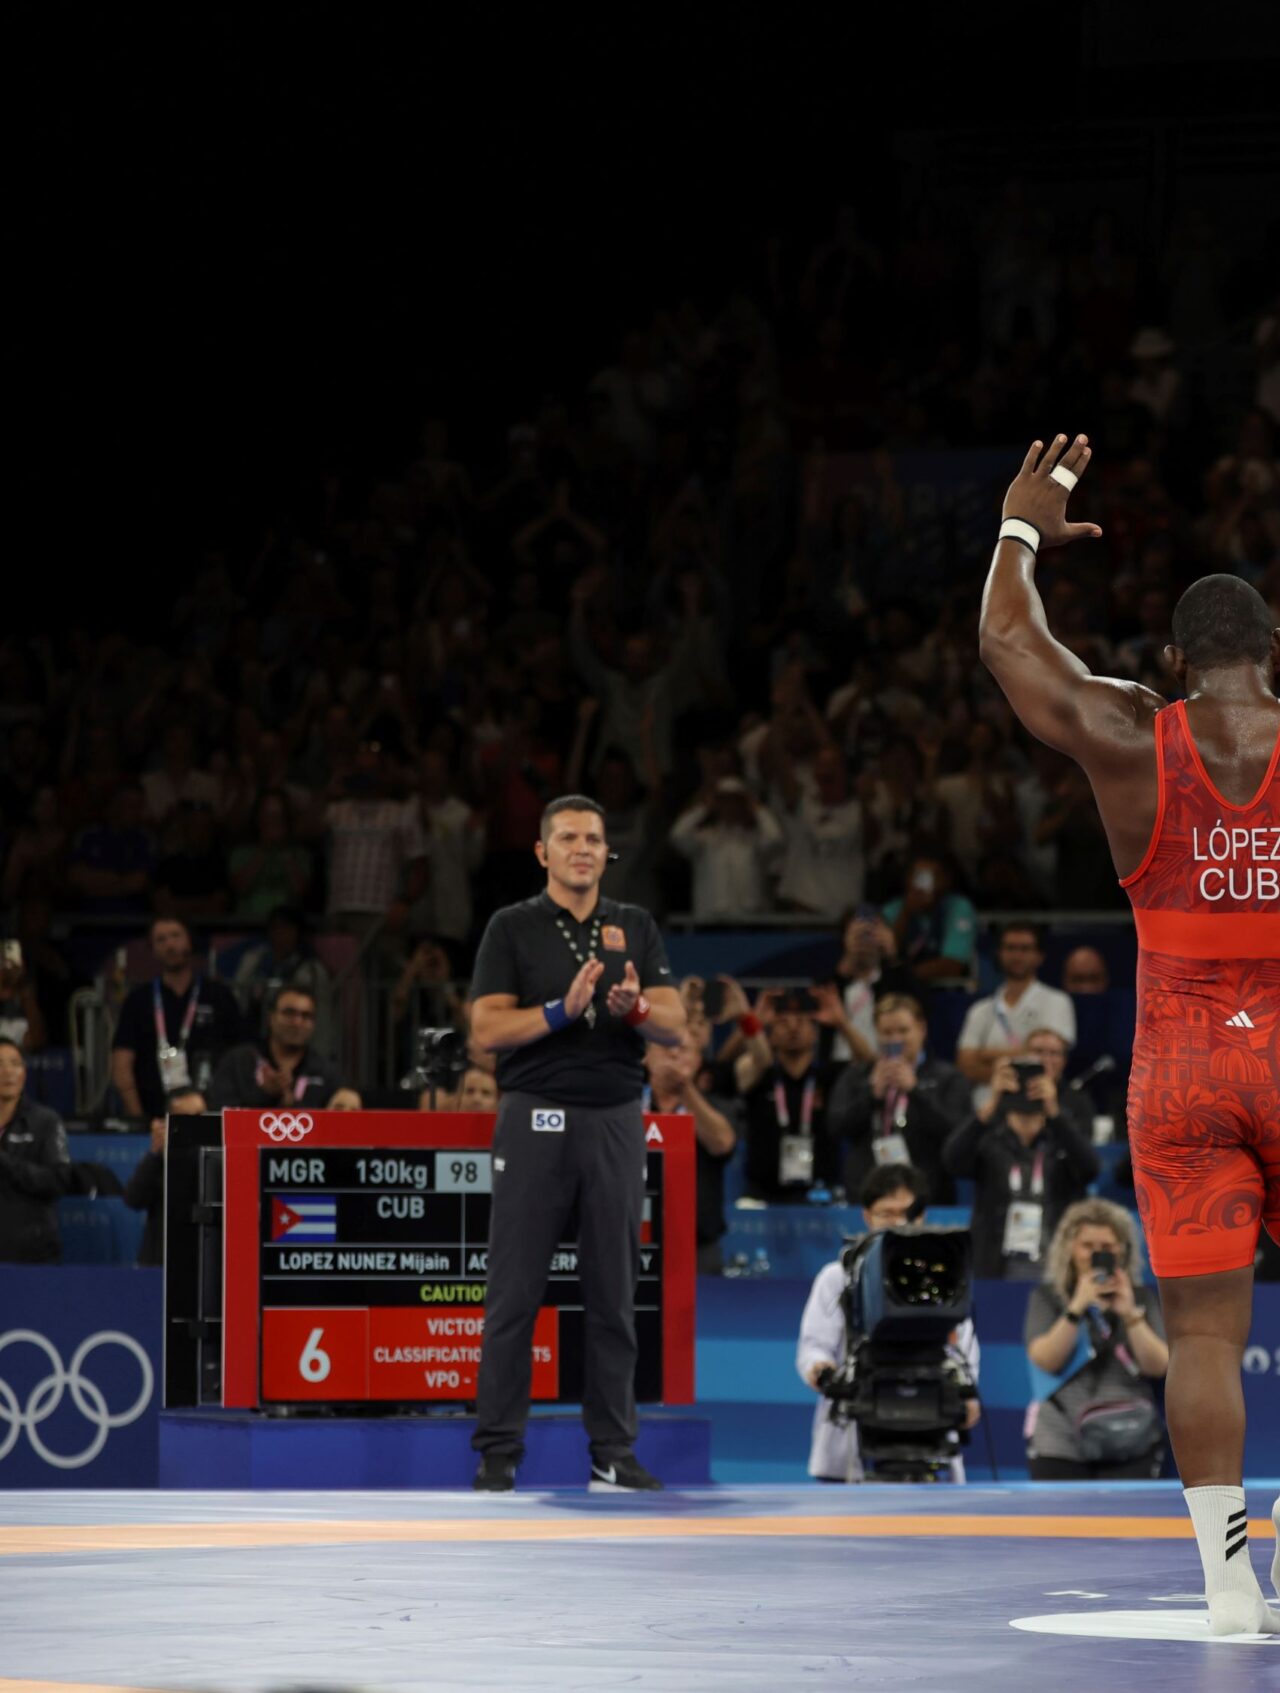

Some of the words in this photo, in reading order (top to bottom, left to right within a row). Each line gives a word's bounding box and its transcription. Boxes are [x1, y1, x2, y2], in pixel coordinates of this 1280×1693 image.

[1200, 868, 1280, 901] CUB
[535, 1113, 562, 1128] 50
[269, 1159, 326, 1184] MGR
[356, 1159, 428, 1190] 130kg
[450, 1161, 478, 1184] 98
[377, 1196, 425, 1219] CUB
[279, 1253, 334, 1270] LOPEZ
[337, 1253, 396, 1270] NUNEZ
[400, 1252, 449, 1274] Mijain
[300, 1329, 331, 1382] 6
[374, 1347, 482, 1363] CLASSIFICATIO
[425, 1371, 460, 1388] VPO
